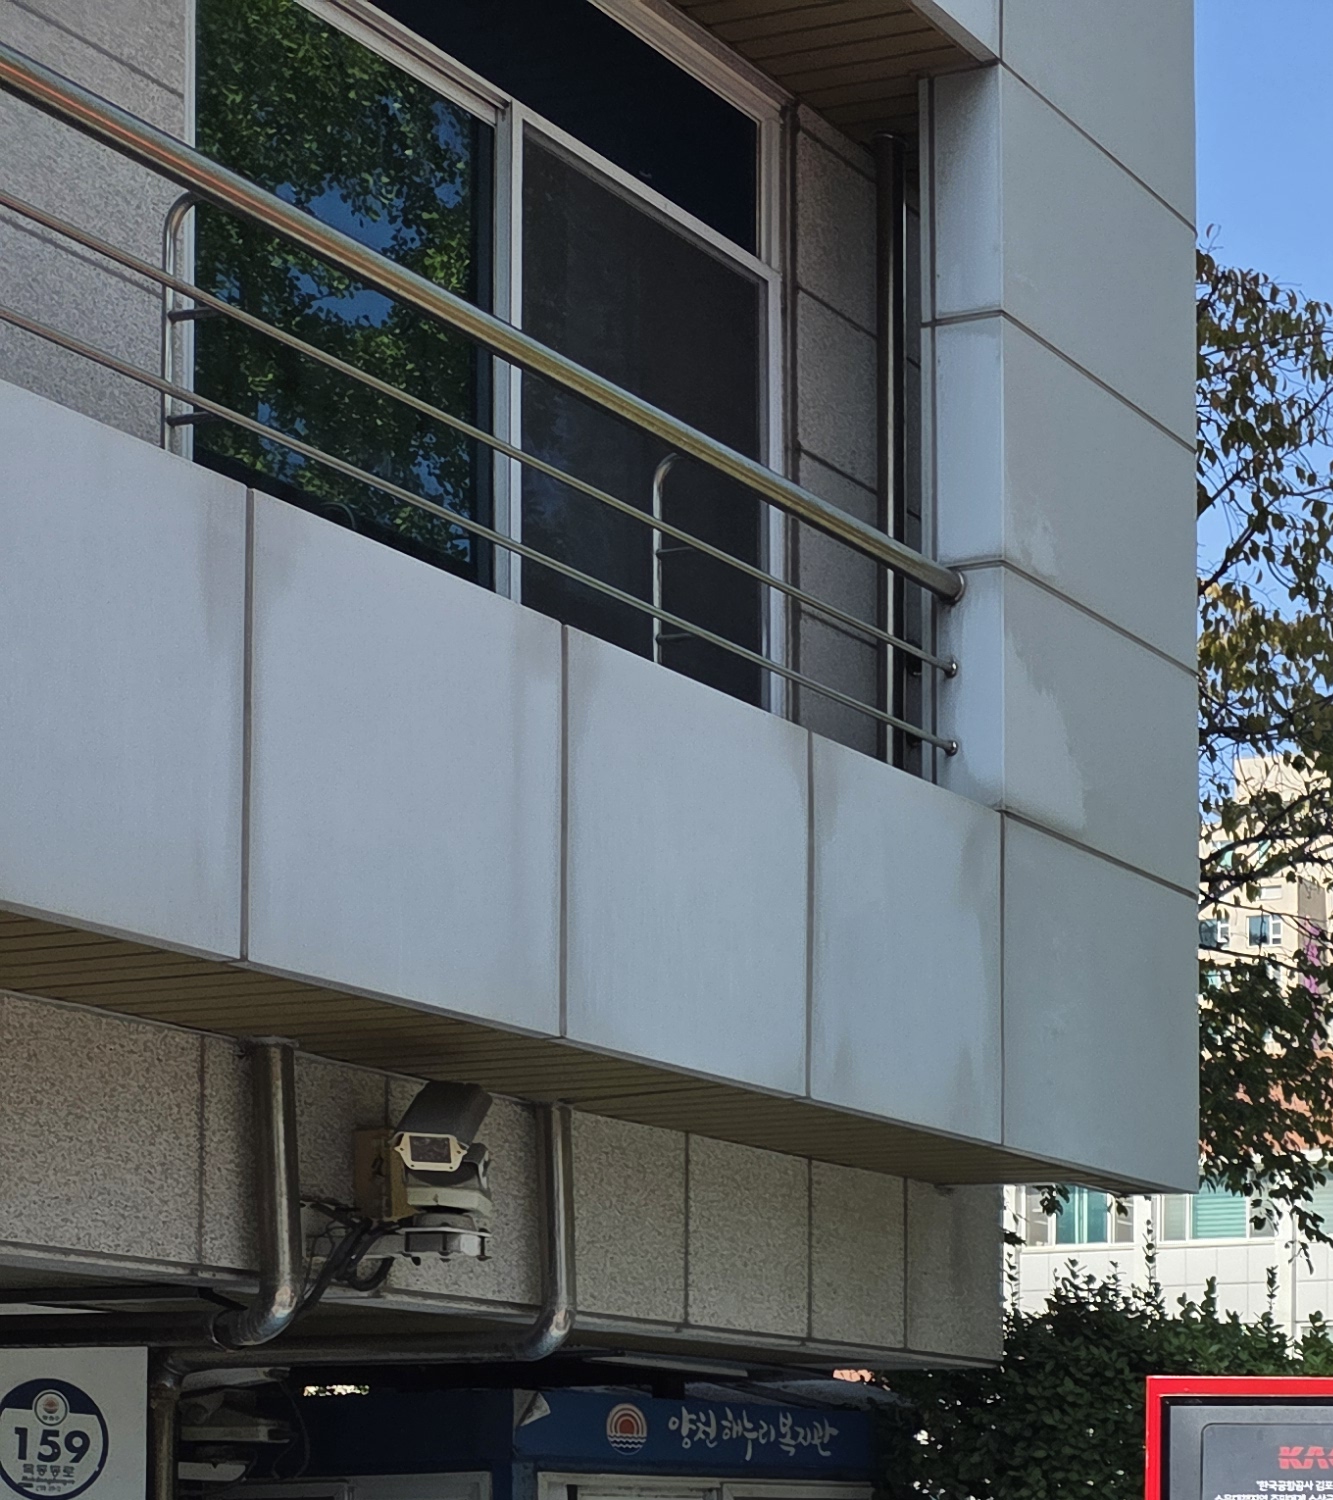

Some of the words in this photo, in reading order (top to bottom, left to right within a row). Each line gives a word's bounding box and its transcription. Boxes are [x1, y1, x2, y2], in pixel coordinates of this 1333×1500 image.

[14, 1427, 91, 1464] 159
[668, 1406, 718, 1449] 양천
[721, 1407, 775, 1461] 해누리
[779, 1411, 839, 1456] 복지관
